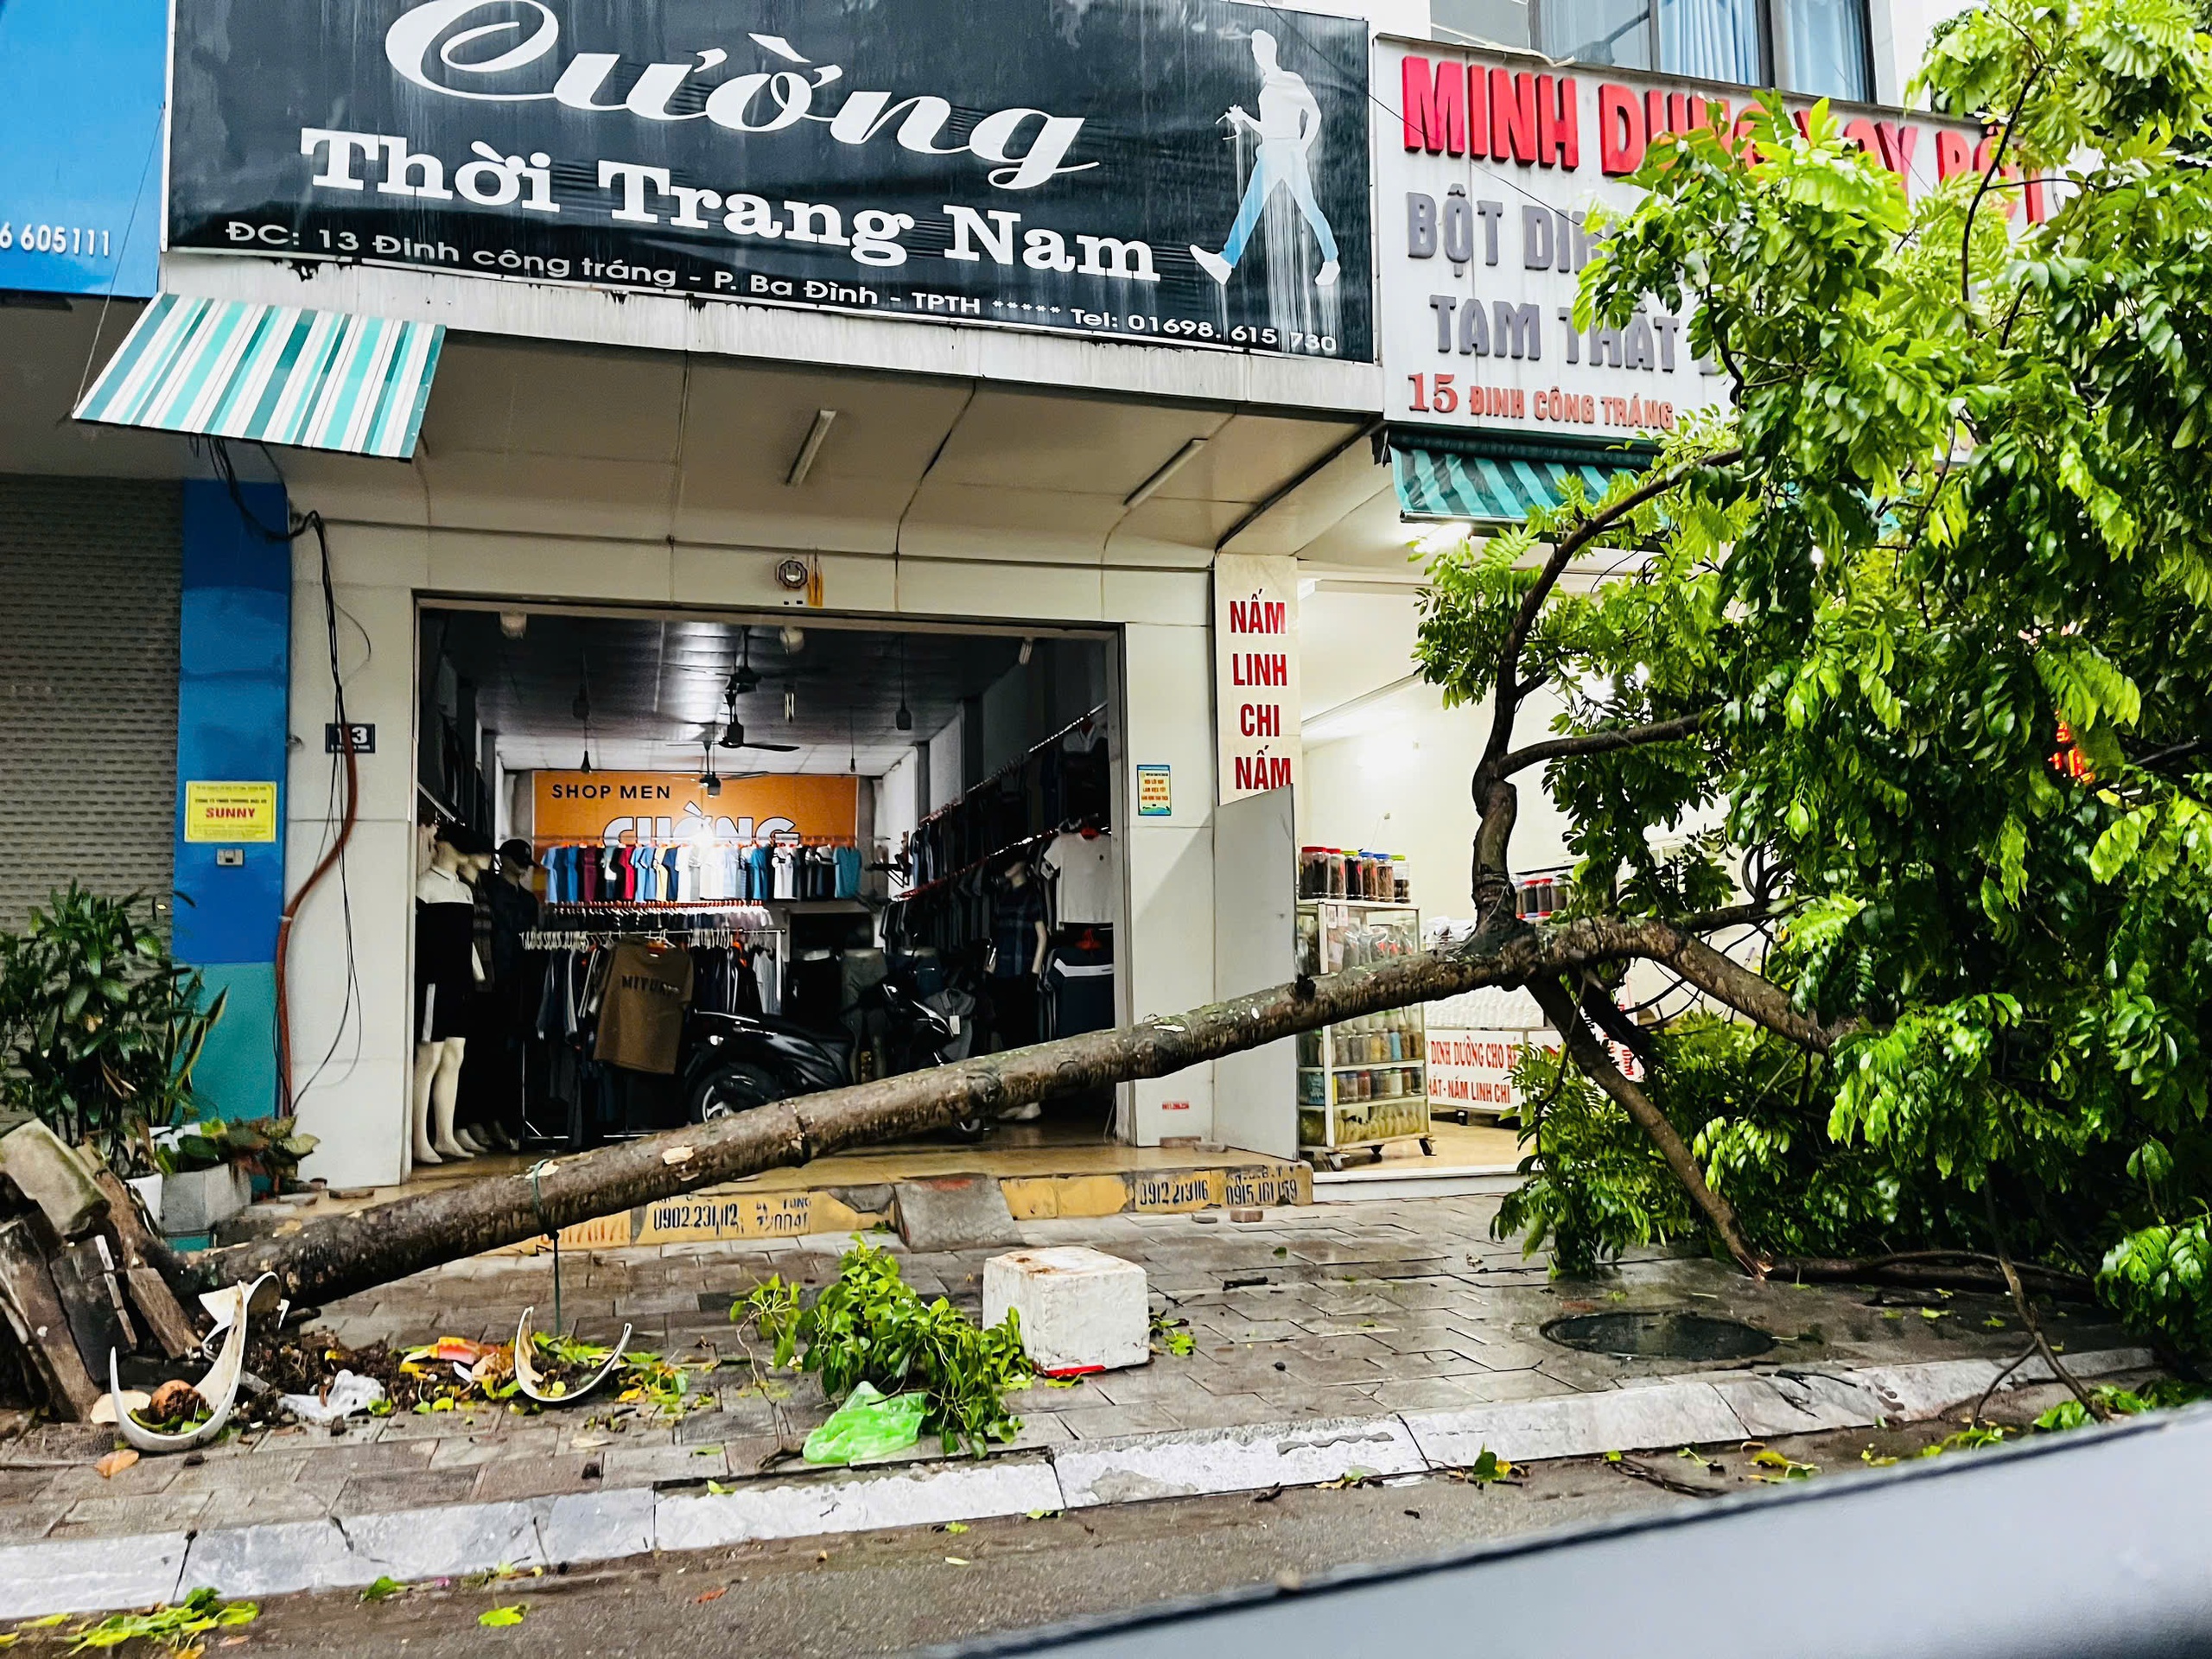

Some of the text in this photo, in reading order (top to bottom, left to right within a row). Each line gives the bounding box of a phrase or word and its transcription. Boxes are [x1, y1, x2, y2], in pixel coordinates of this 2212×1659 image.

[385, 0, 1100, 189] Cường
[1402, 55, 1579, 172] MINH
[300, 127, 1161, 283] Thời Trang Nam
[21, 224, 110, 257] 605111
[1406, 182, 1503, 277] BỘT
[226, 221, 300, 245] ĐC:
[319, 229, 359, 251] 13
[372, 234, 459, 262] Đinh
[473, 250, 570, 278] công
[582, 258, 677, 288] tráng
[715, 270, 737, 290] P.
[750, 274, 793, 296] Ba
[803, 281, 879, 305] Đình
[911, 292, 981, 314] TPTH
[1071, 308, 1118, 328] Tel:
[1231, 325, 1278, 345] 615
[1290, 331, 1337, 353] 730
[1429, 295, 1541, 360] TAM
[1408, 372, 1458, 413] 15
[1533, 385, 1594, 424] CÔNG
[1600, 392, 1675, 431] TRÁNG
[1230, 588, 1287, 634] NẤM
[1232, 653, 1287, 686] LINH
[1240, 703, 1280, 737] CHI
[1235, 744, 1291, 790] NẤM
[206, 807, 255, 818] SUNNY
[551, 784, 671, 799] SHOP MEN
[1486, 1043, 1503, 1069] CHO
[1471, 1082, 1492, 1103] LINH
[1494, 1084, 1510, 1104] CHI
